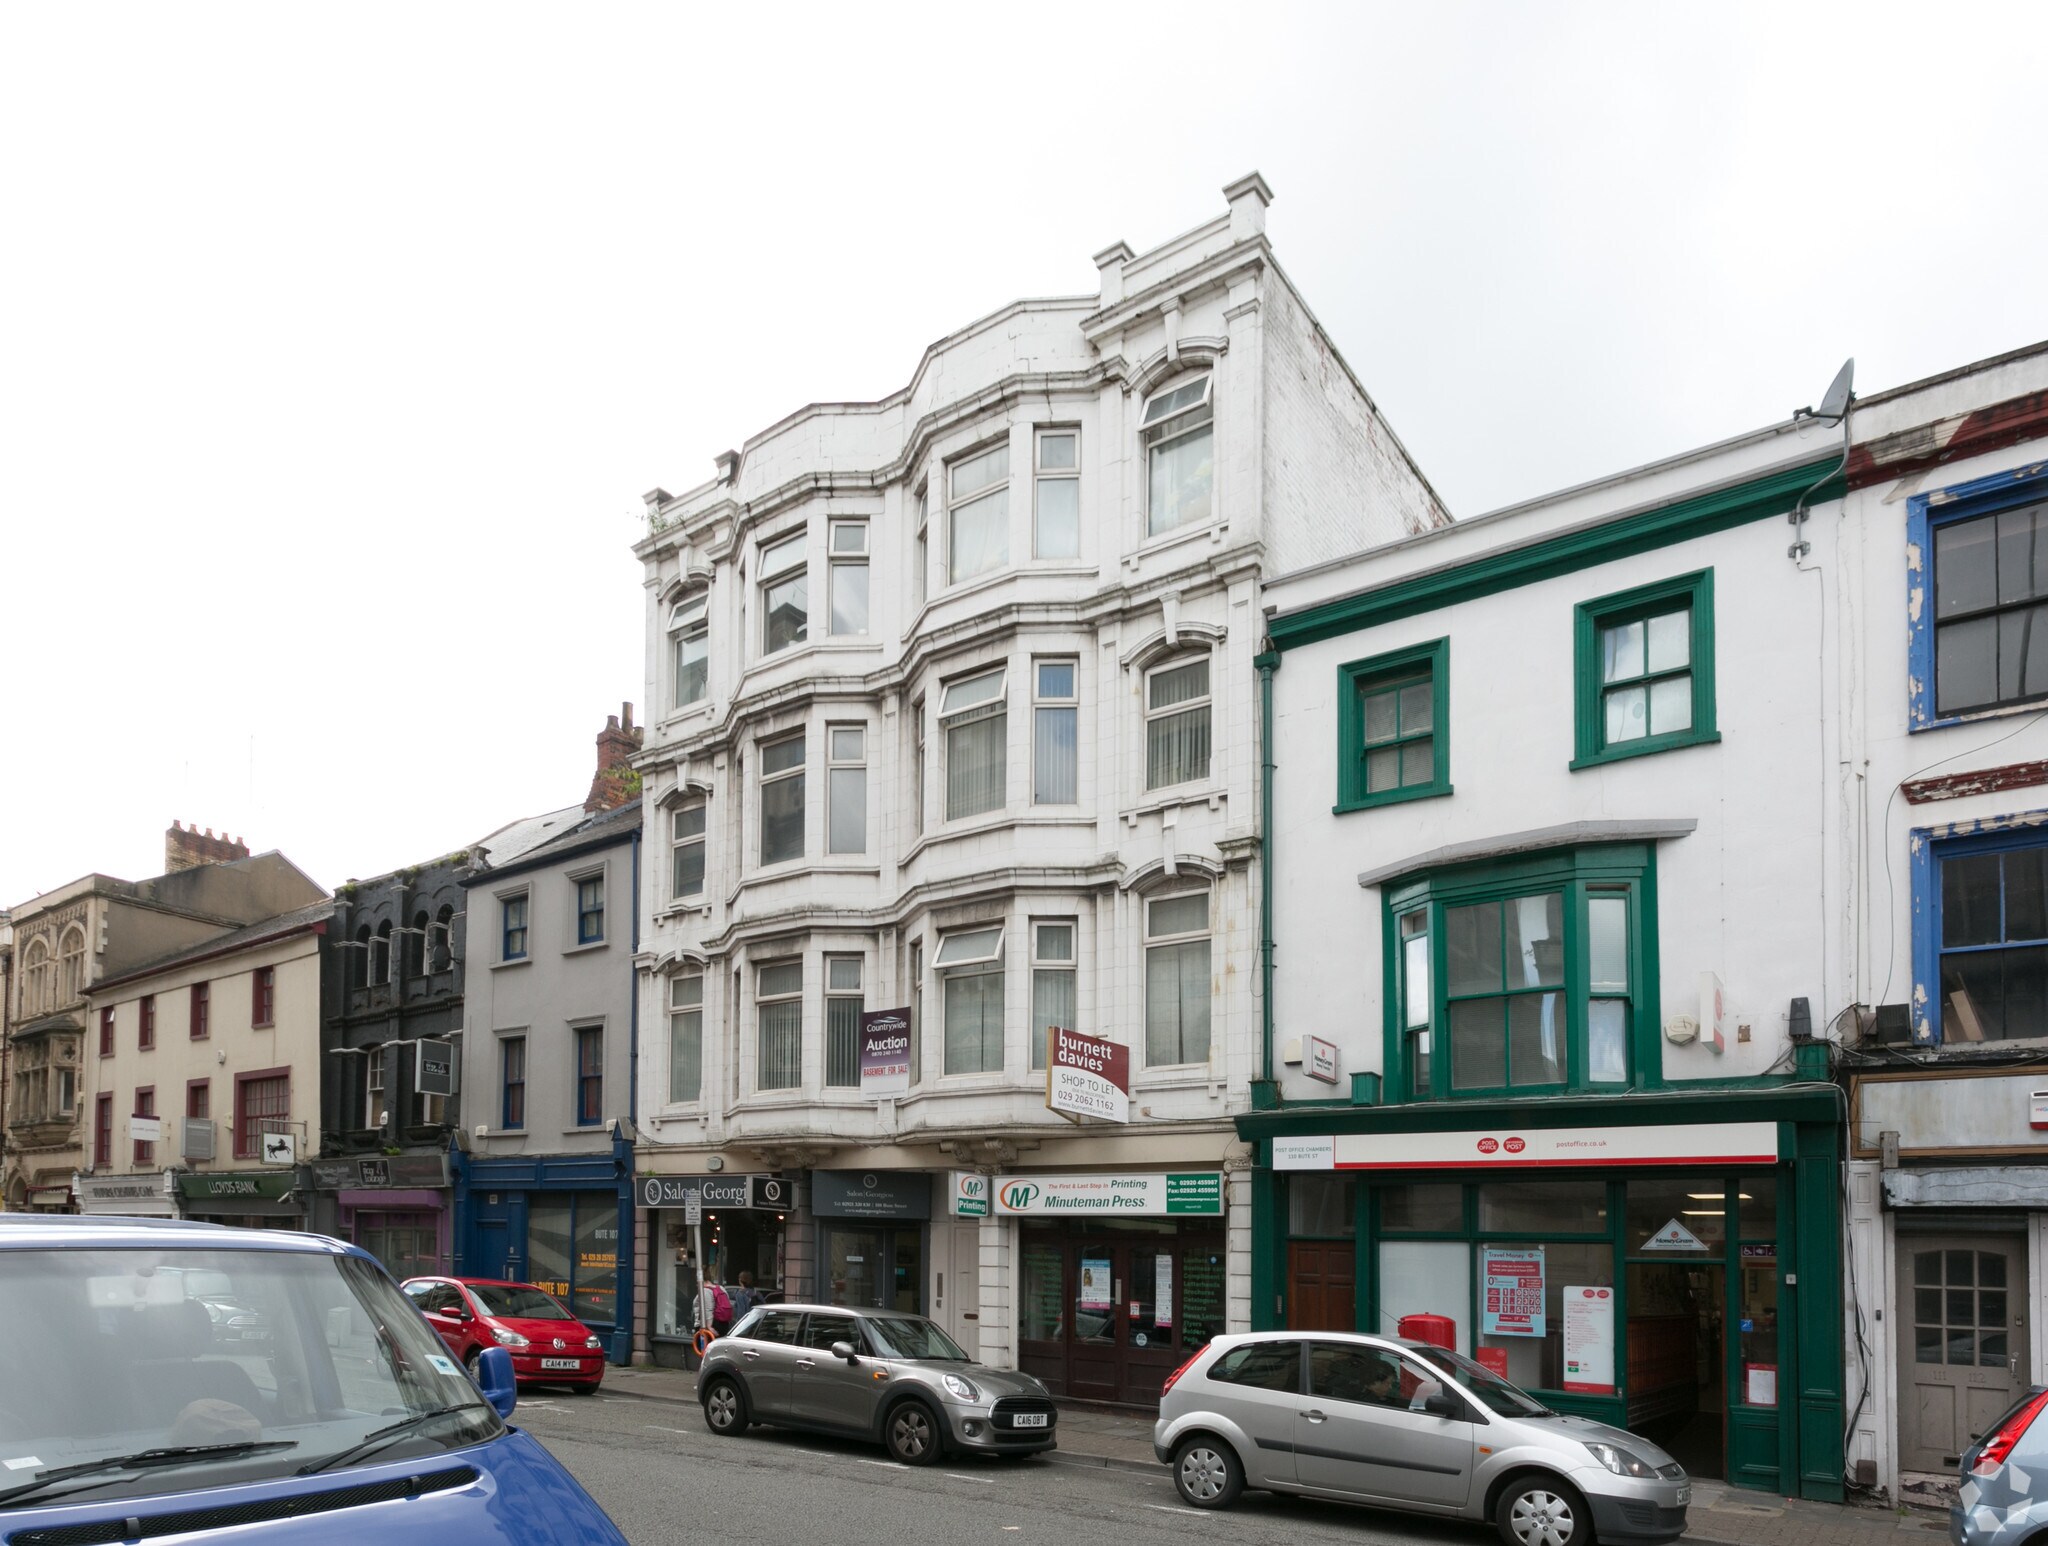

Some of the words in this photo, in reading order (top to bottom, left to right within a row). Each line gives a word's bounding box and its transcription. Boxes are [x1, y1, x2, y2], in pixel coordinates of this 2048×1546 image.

[867, 1021, 907, 1032] Countrywide
[866, 1036, 907, 1051] Auction
[1060, 1028, 1112, 1060] burnett
[1058, 1048, 1103, 1071] davies
[864, 1067, 886, 1077] BASEMENT
[888, 1066, 896, 1075] FOR
[898, 1064, 907, 1073] SALE
[1062, 1074, 1085, 1087] SHOP
[1087, 1080, 1098, 1091] TO
[1102, 1084, 1114, 1095] LET
[1058, 1090, 1072, 1101] 029
[1075, 1094, 1093, 1106] 2062
[1097, 1099, 1114, 1110] 1162
[1556, 1140, 1607, 1148] postoffice.co.uk
[208, 1181, 236, 1193] LLOYDS
[235, 1181, 258, 1193] BANK
[664, 1182, 699, 1200] Salo
[1111, 1180, 1148, 1190] Printing
[959, 1200, 986, 1212] Printing
[1044, 1196, 1110, 1208] Minuteman
[594, 1229, 608, 1240] BUTE
[609, 1229, 618, 1240] 107
[538, 1282, 554, 1295] BUTE
[557, 1282, 569, 1296] 107
[546, 1360, 560, 1368] CA14
[1933, 1370, 1946, 1380] 111
[1968, 1372, 1986, 1384] 112
[1017, 1416, 1032, 1425] CA16
